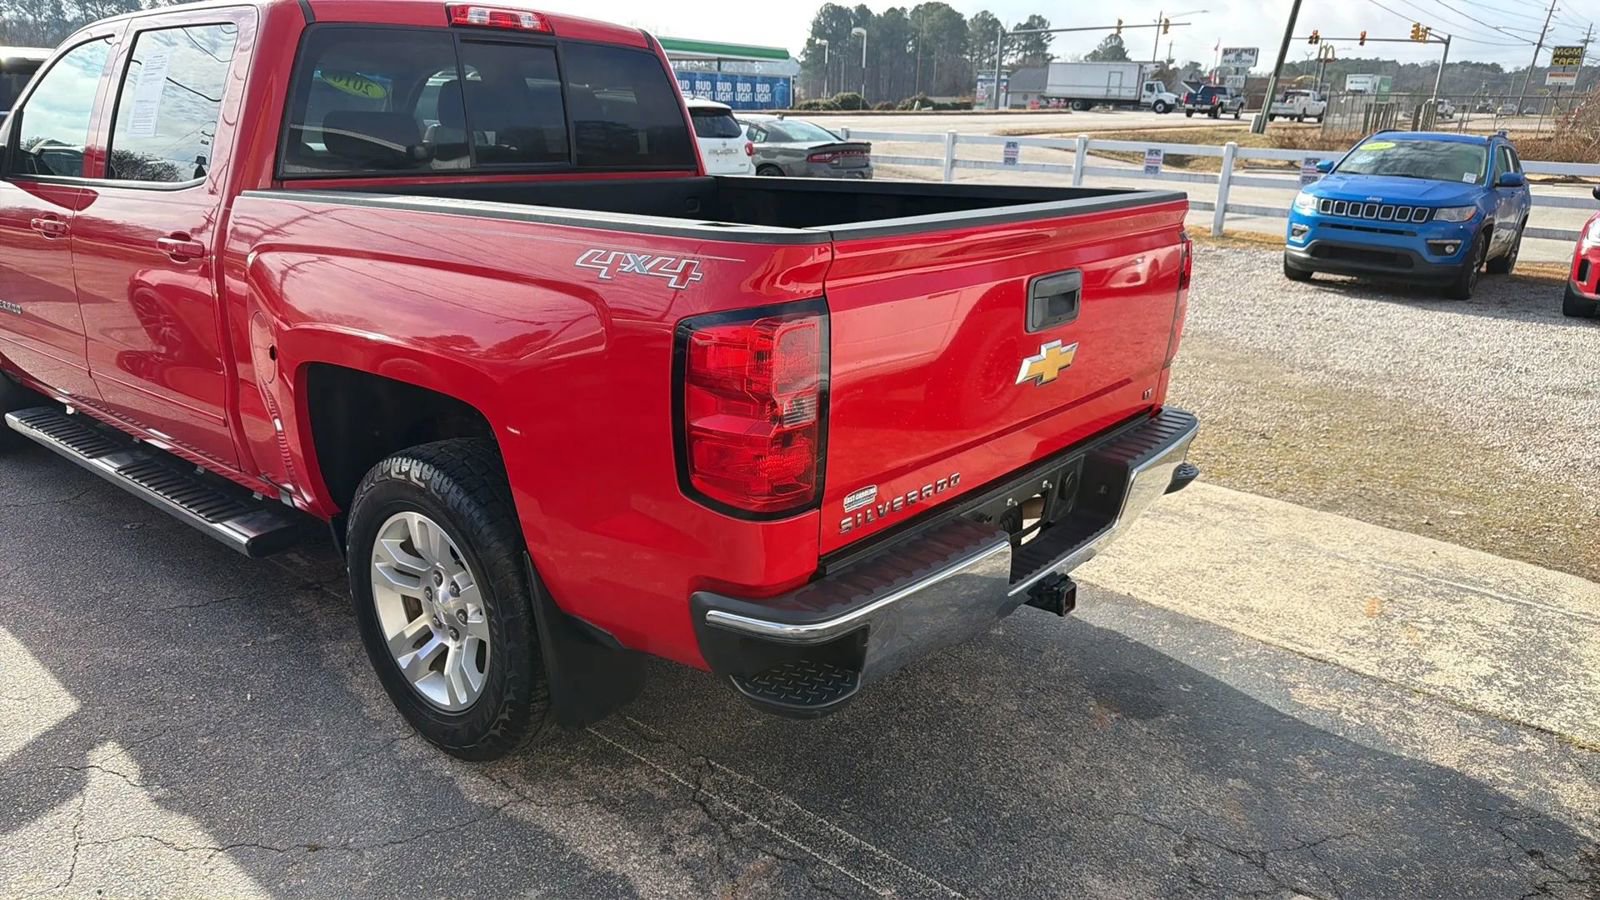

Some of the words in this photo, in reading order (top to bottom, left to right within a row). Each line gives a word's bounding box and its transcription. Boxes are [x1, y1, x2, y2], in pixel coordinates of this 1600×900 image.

[695, 81, 712, 90] BUD
[716, 82, 732, 91] BUD
[736, 83, 751, 92] BUD
[755, 83, 770, 93] BUD
[715, 91, 733, 102] LIGHT
[735, 92, 753, 102] LIGHT
[754, 93, 772, 103] LIGHT
[839, 472, 960, 534] SILVERADO
